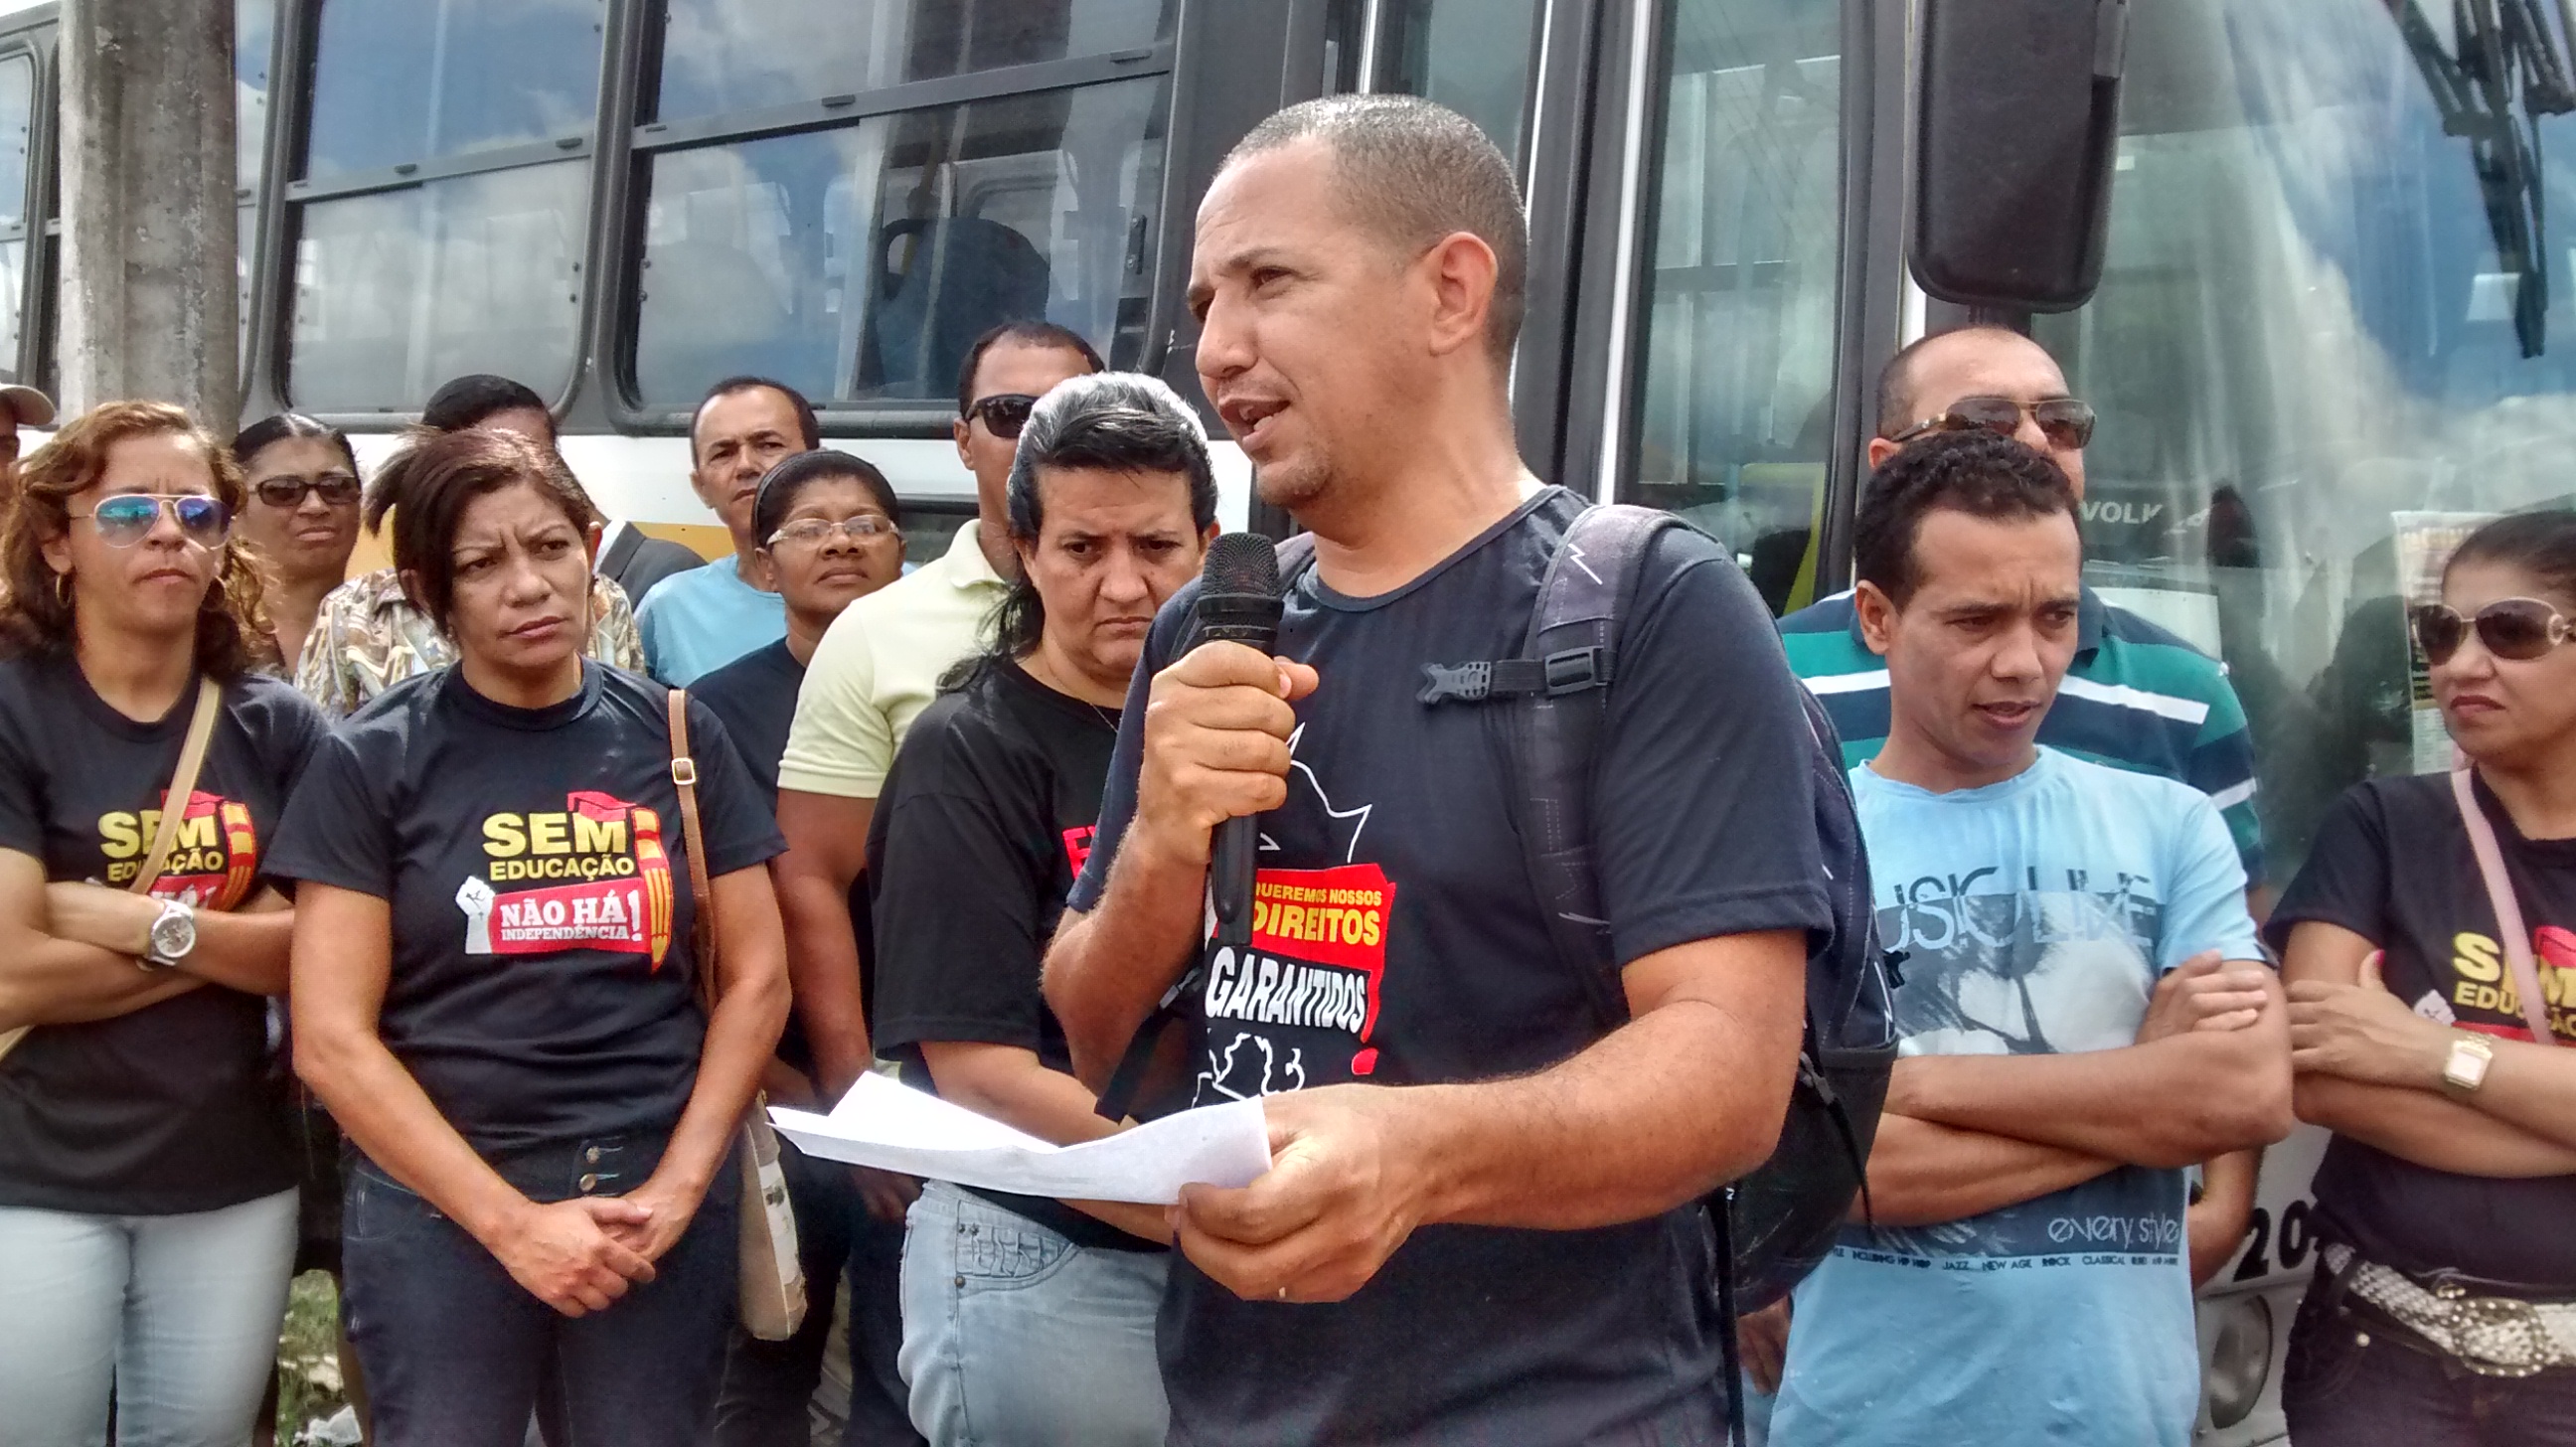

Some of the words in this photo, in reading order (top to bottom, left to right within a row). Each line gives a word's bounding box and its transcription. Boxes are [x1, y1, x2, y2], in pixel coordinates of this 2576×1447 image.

[482, 812, 627, 858] SEM
[489, 854, 635, 883] EDUCAÇÃO
[500, 897, 565, 927] NÃO
[1329, 888, 1383, 907] NOSSOS
[1882, 865, 2020, 953] USIC
[501, 924, 630, 941] INDEPENDÊNCIA
[1252, 902, 1381, 946] DIREITOS
[1205, 945, 1367, 1035] GARANTIDOS
[1943, 1260, 1970, 1270] JAZZ
[1982, 1259, 2008, 1271] NEW
[2011, 1258, 2032, 1270] AGE
